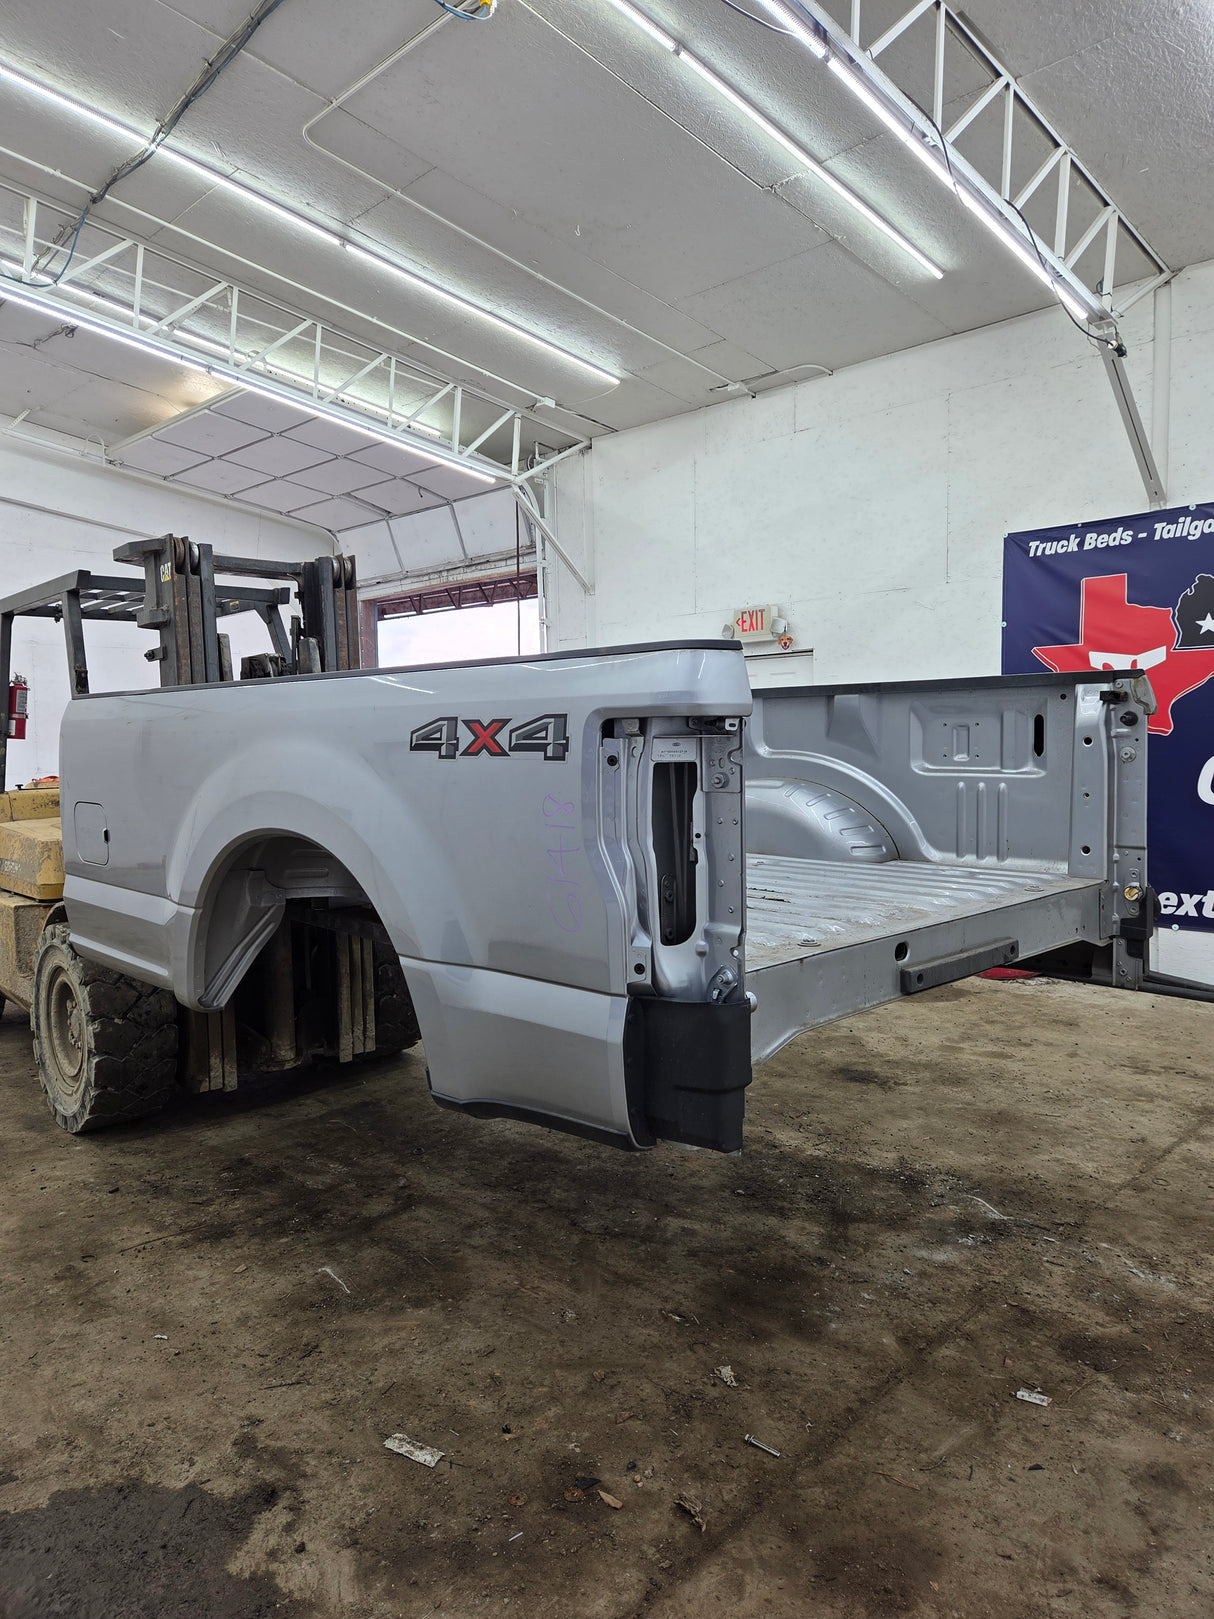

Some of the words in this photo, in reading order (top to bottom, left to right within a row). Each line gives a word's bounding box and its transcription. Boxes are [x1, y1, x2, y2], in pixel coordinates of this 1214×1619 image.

[1028, 534, 1081, 557] Truck
[1083, 527, 1133, 550] Beds
[160, 562, 172, 583] CAT
[740, 608, 766, 633] EXIT
[409, 712, 570, 762] 4X4
